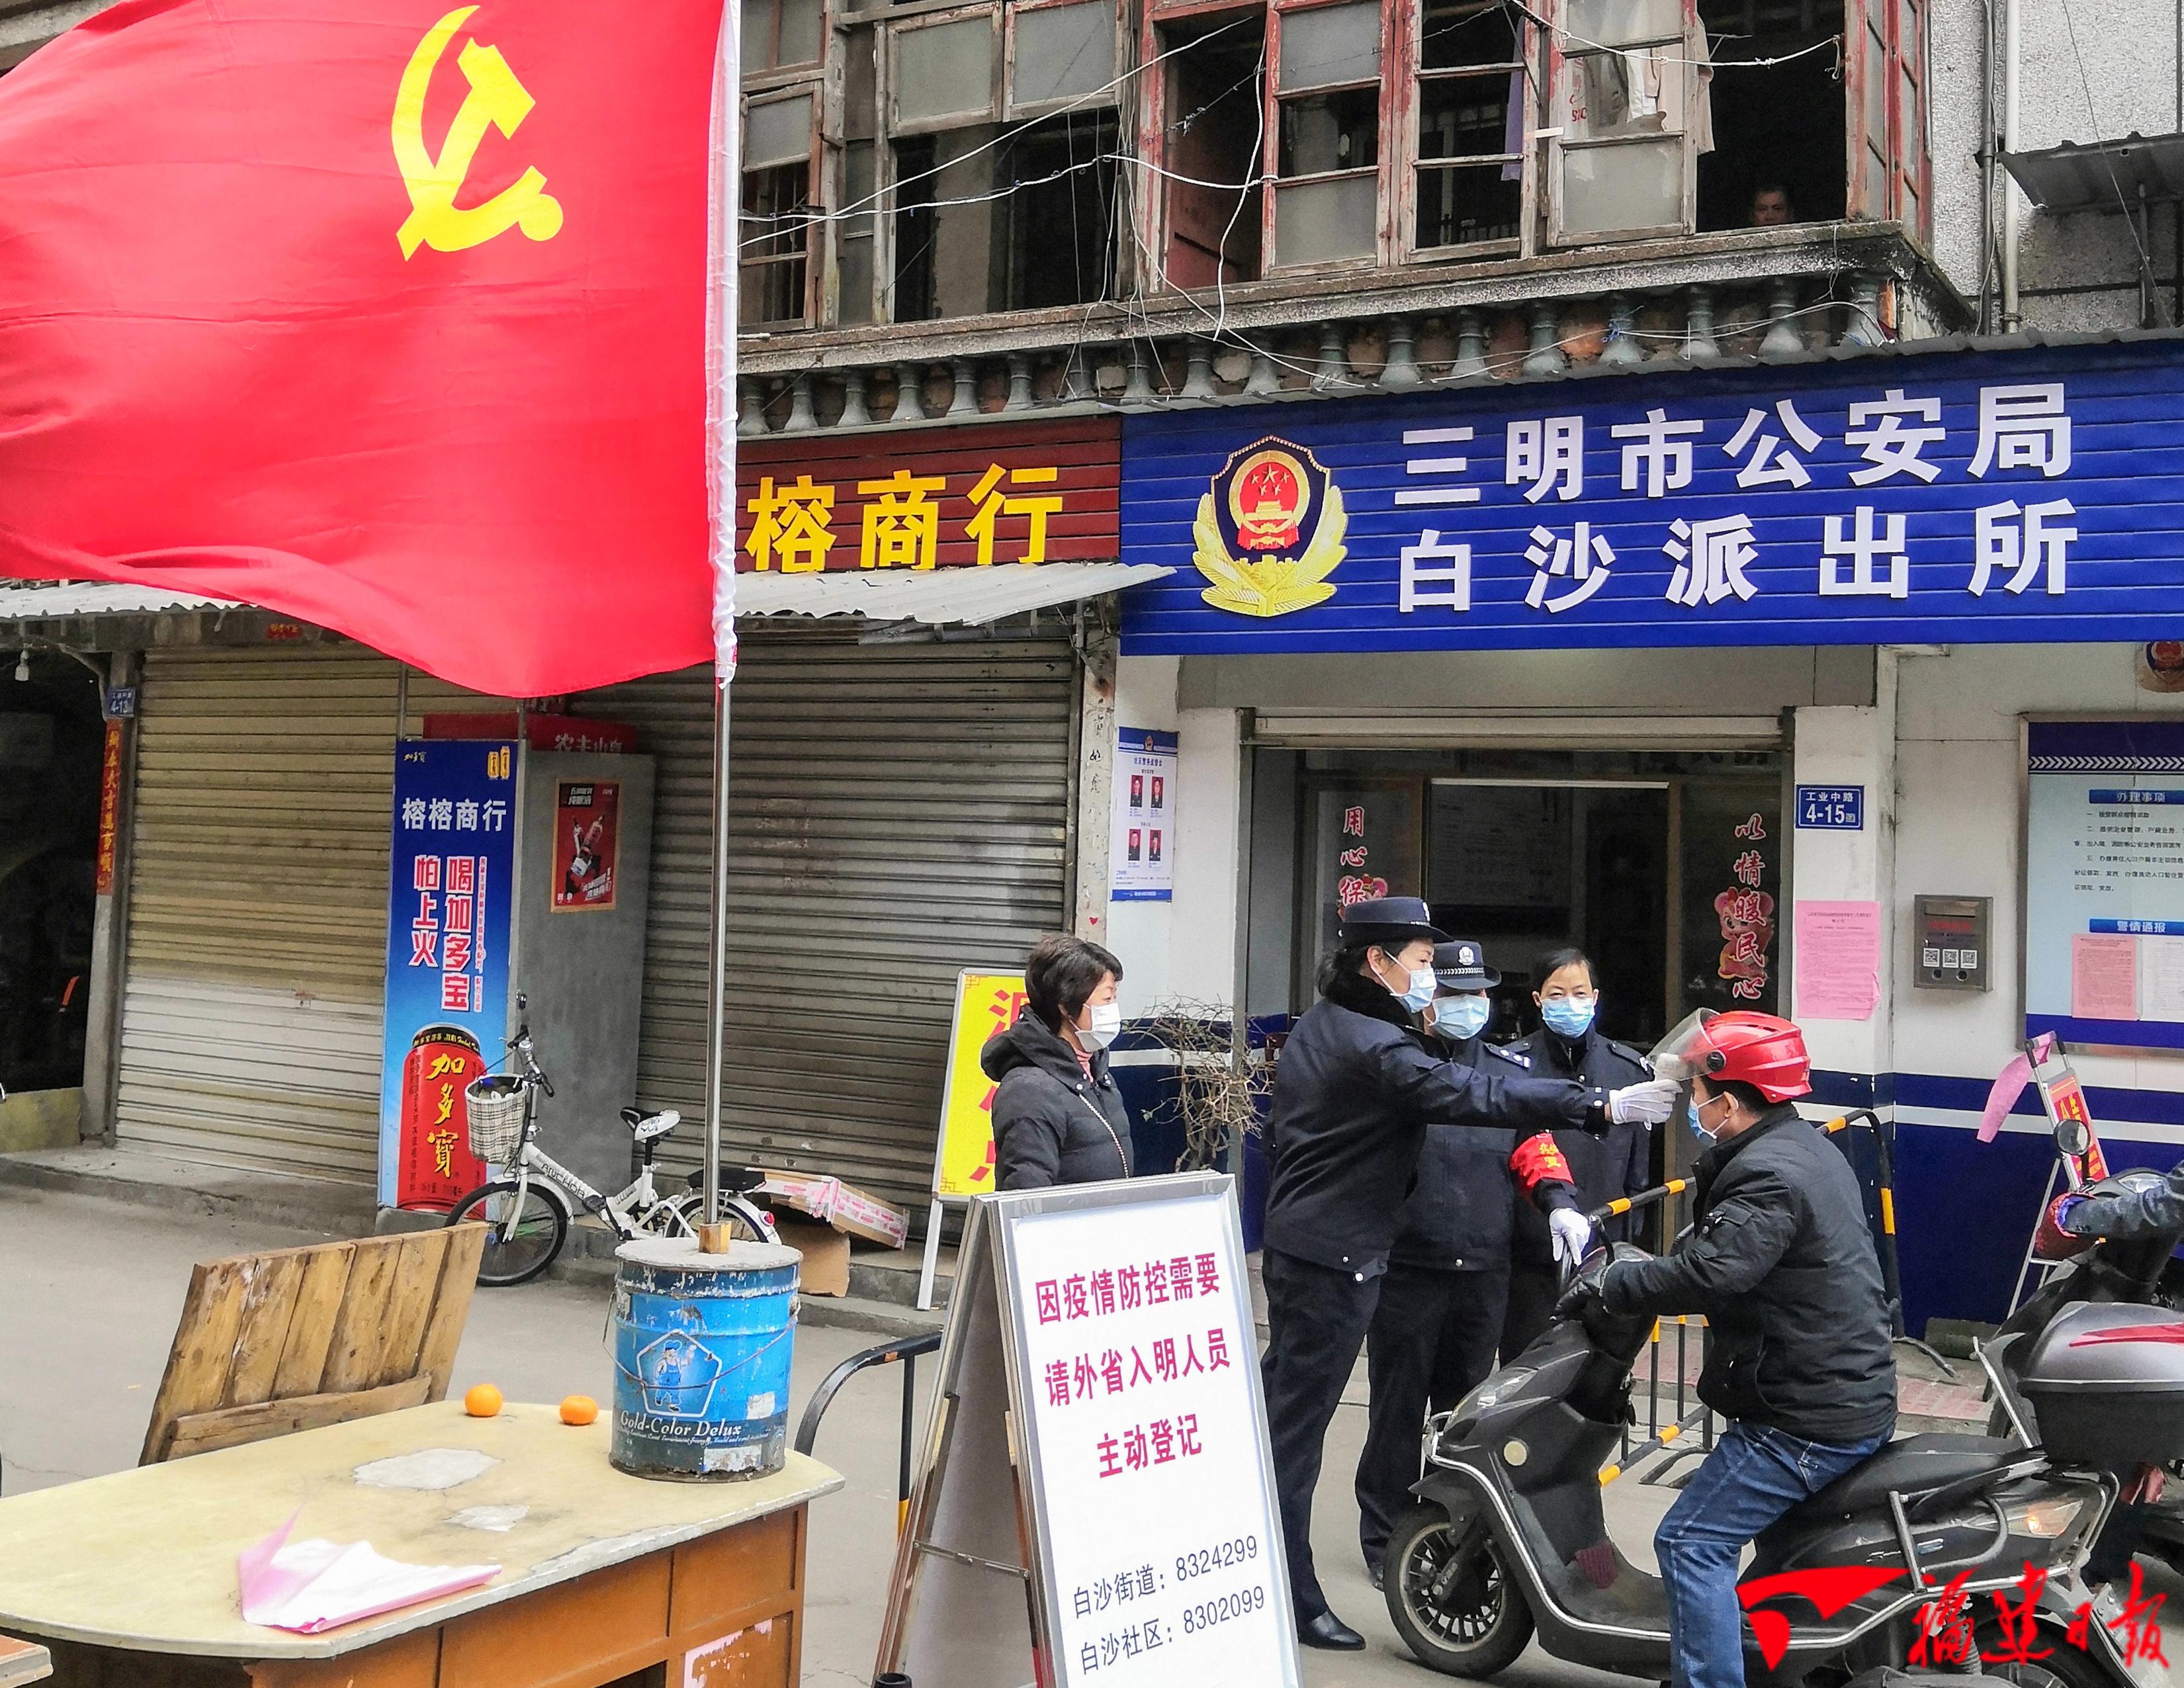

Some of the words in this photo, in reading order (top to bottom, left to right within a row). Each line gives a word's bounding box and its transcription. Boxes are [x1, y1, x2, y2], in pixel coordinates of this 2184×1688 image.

[1394, 382, 2073, 504] 三明市公安局
[744, 463, 1063, 573] 榕商行
[1398, 498, 2077, 613] 白沙派出所
[402, 797, 507, 832] 榕榕商行
[1805, 791, 1853, 803] 工业中路
[2117, 792, 2165, 803] 办理事项
[409, 855, 441, 967] 怕上火
[442, 856, 475, 1011] 喝加多宝
[1732, 813, 1767, 1000] 以情暖民心
[2117, 920, 2165, 933] 警情通报
[541, 1163, 586, 1199] ANCHOR
[1035, 1251, 1220, 1325] 因疫情防控需要
[1045, 1327, 1231, 1407] 请外省入明人员
[621, 1410, 691, 1436] Gold-Color
[695, 1418, 742, 1437] Delux
[1097, 1413, 1202, 1478] 主动登记
